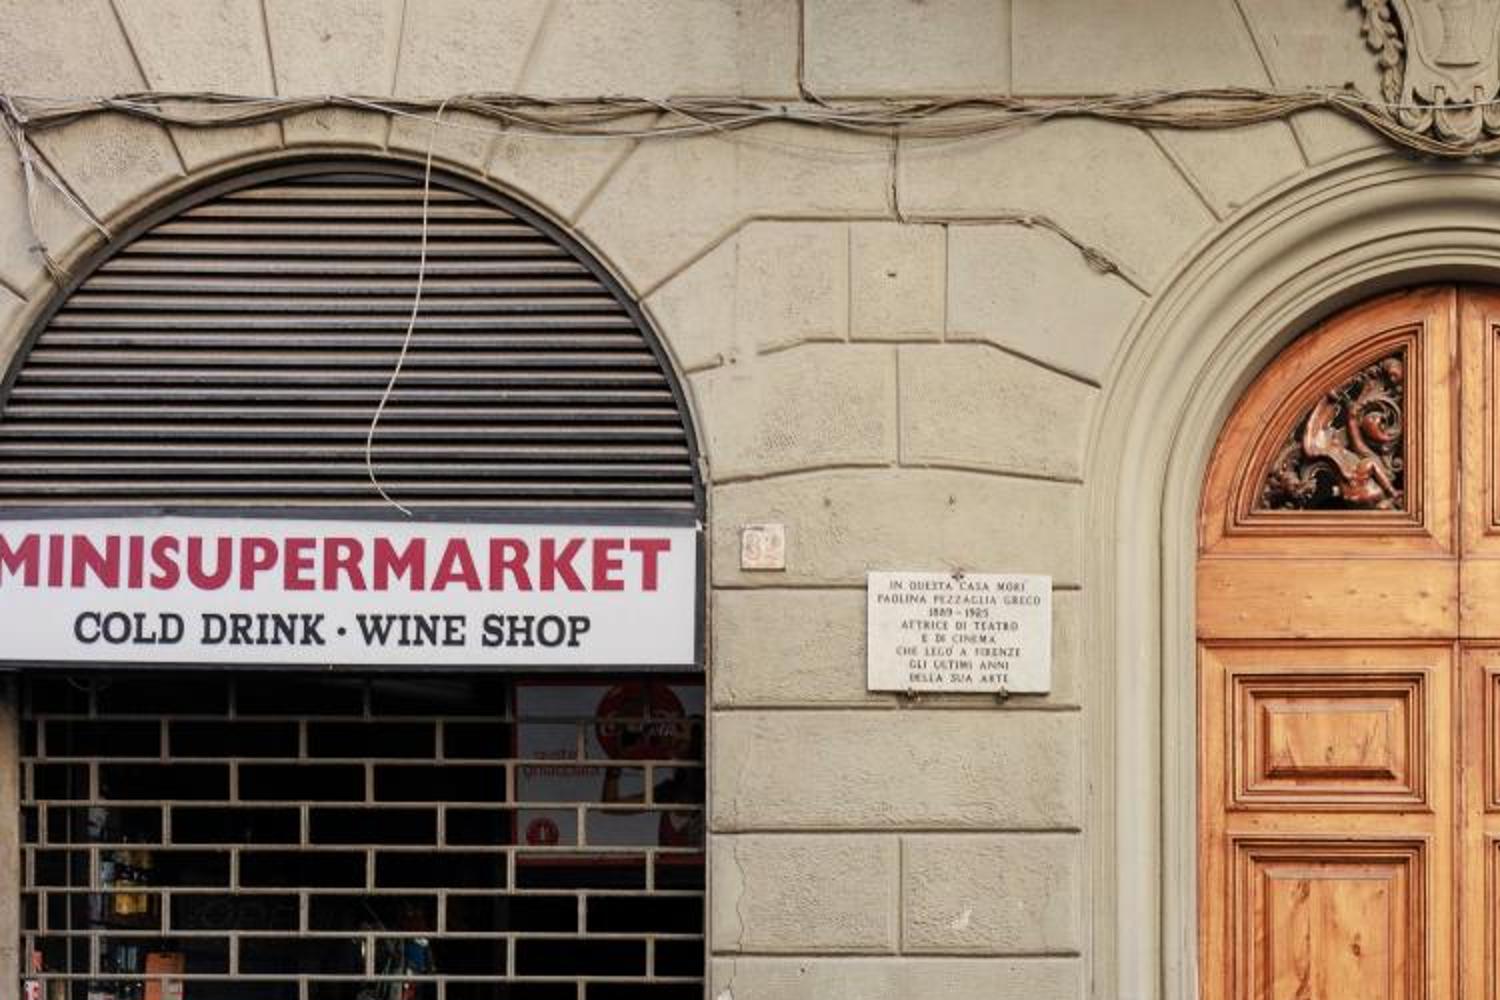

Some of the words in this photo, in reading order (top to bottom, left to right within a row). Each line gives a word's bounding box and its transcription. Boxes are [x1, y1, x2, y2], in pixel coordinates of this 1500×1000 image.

[0, 533, 671, 592] MINISUPERMARKET
[890, 581, 902, 590] IN
[959, 581, 989, 591] CASA
[1003, 595, 1041, 605] GRECO
[73, 611, 185, 645] COLD
[200, 612, 326, 645] DRINK
[355, 614, 466, 647] WINE
[481, 613, 591, 648] SHOP
[956, 621, 966, 630] DI
[974, 621, 1019, 631] TEATRO
[921, 634, 927, 643] E
[952, 634, 995, 643] CINEMA
[896, 646, 917, 656] CHE
[960, 648, 967, 656] A
[909, 659, 927, 669] GLI
[980, 661, 1009, 670] ANNI
